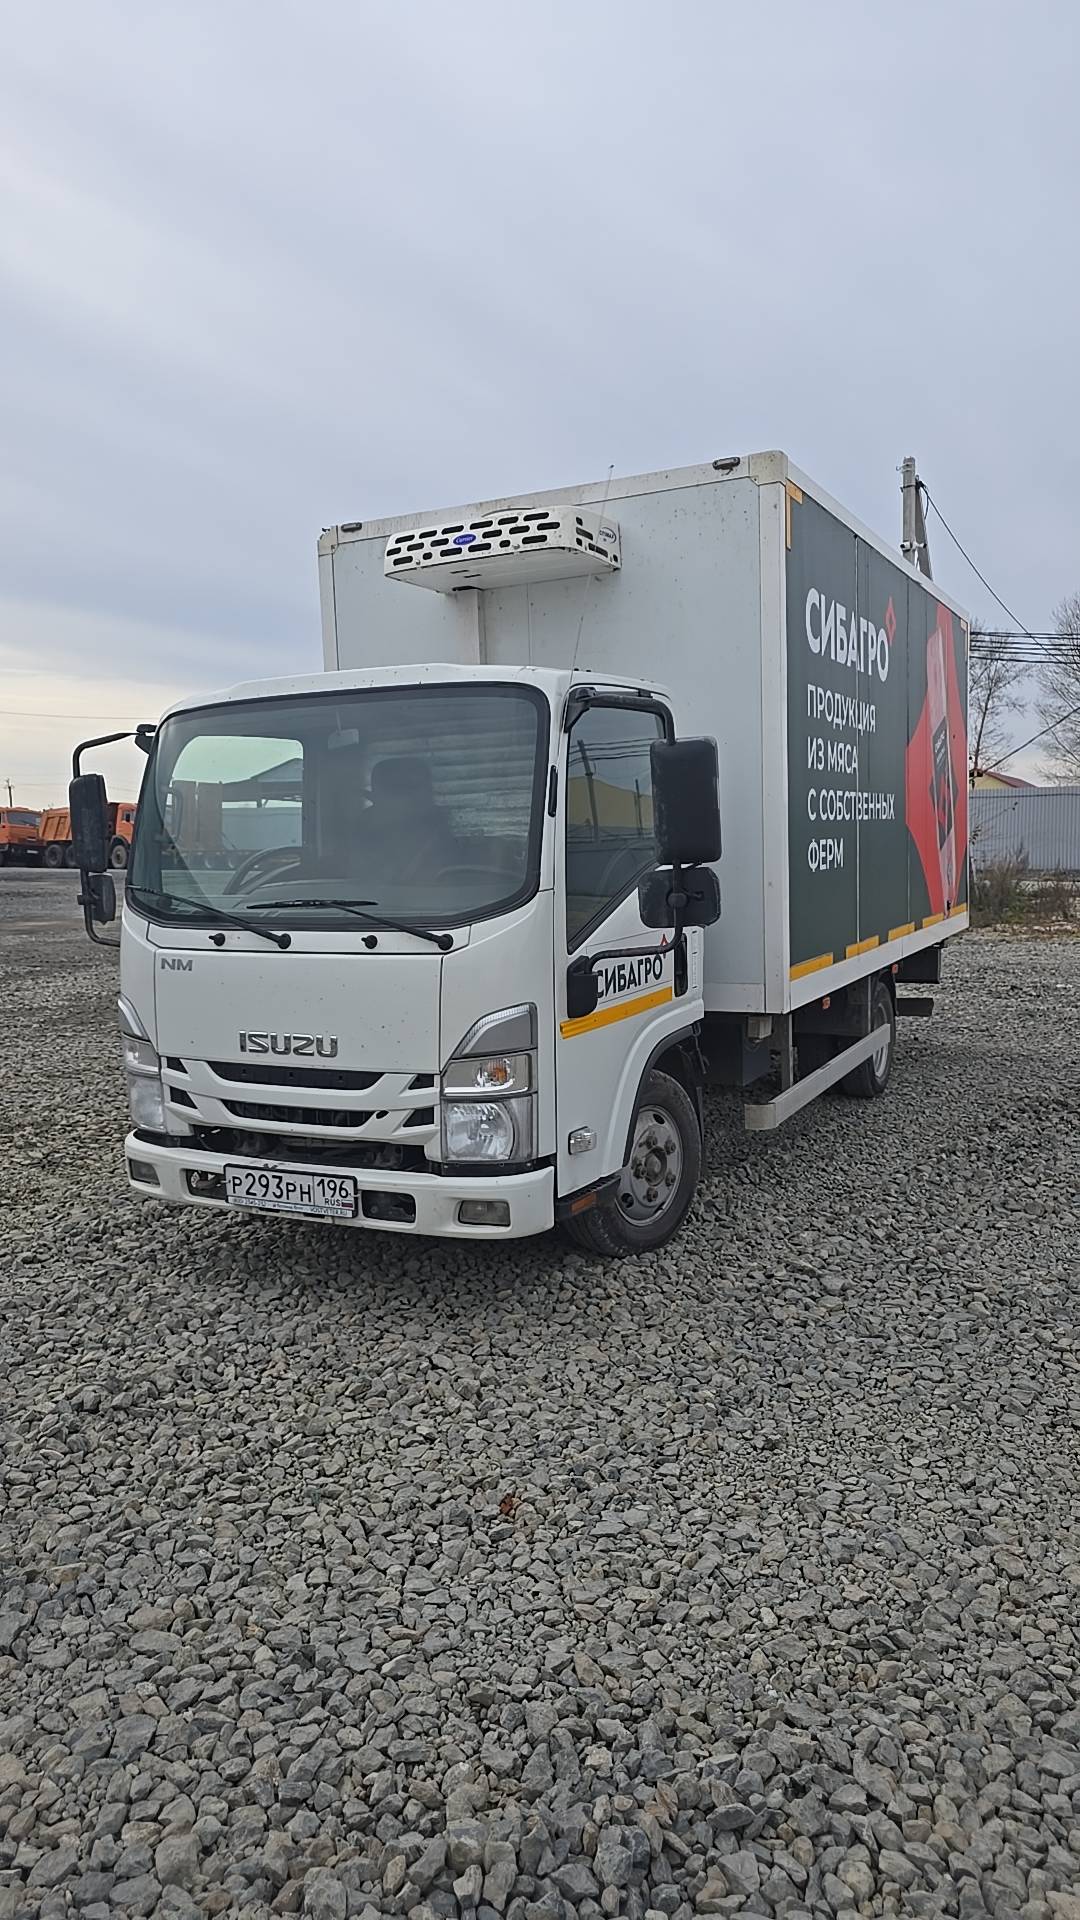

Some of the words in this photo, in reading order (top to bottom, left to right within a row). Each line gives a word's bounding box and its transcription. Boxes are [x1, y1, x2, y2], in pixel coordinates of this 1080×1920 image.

[805, 588, 889, 682] СИБАГРО
[807, 683, 877, 737] ПРОДУКЦИЯ
[807, 736, 825, 771] ИЗ
[827, 744, 859, 775] МЯСА
[807, 788, 817, 821] С
[819, 789, 896, 821] СОБСТВЕННЫХ
[807, 838, 844, 873] ФЕРМ
[160, 958, 193, 972] NM
[597, 953, 663, 999] СИБАГРО
[238, 1030, 339, 1058] ISUZU
[316, 1178, 349, 1199] 196
[324, 1197, 341, 1207] RUS
